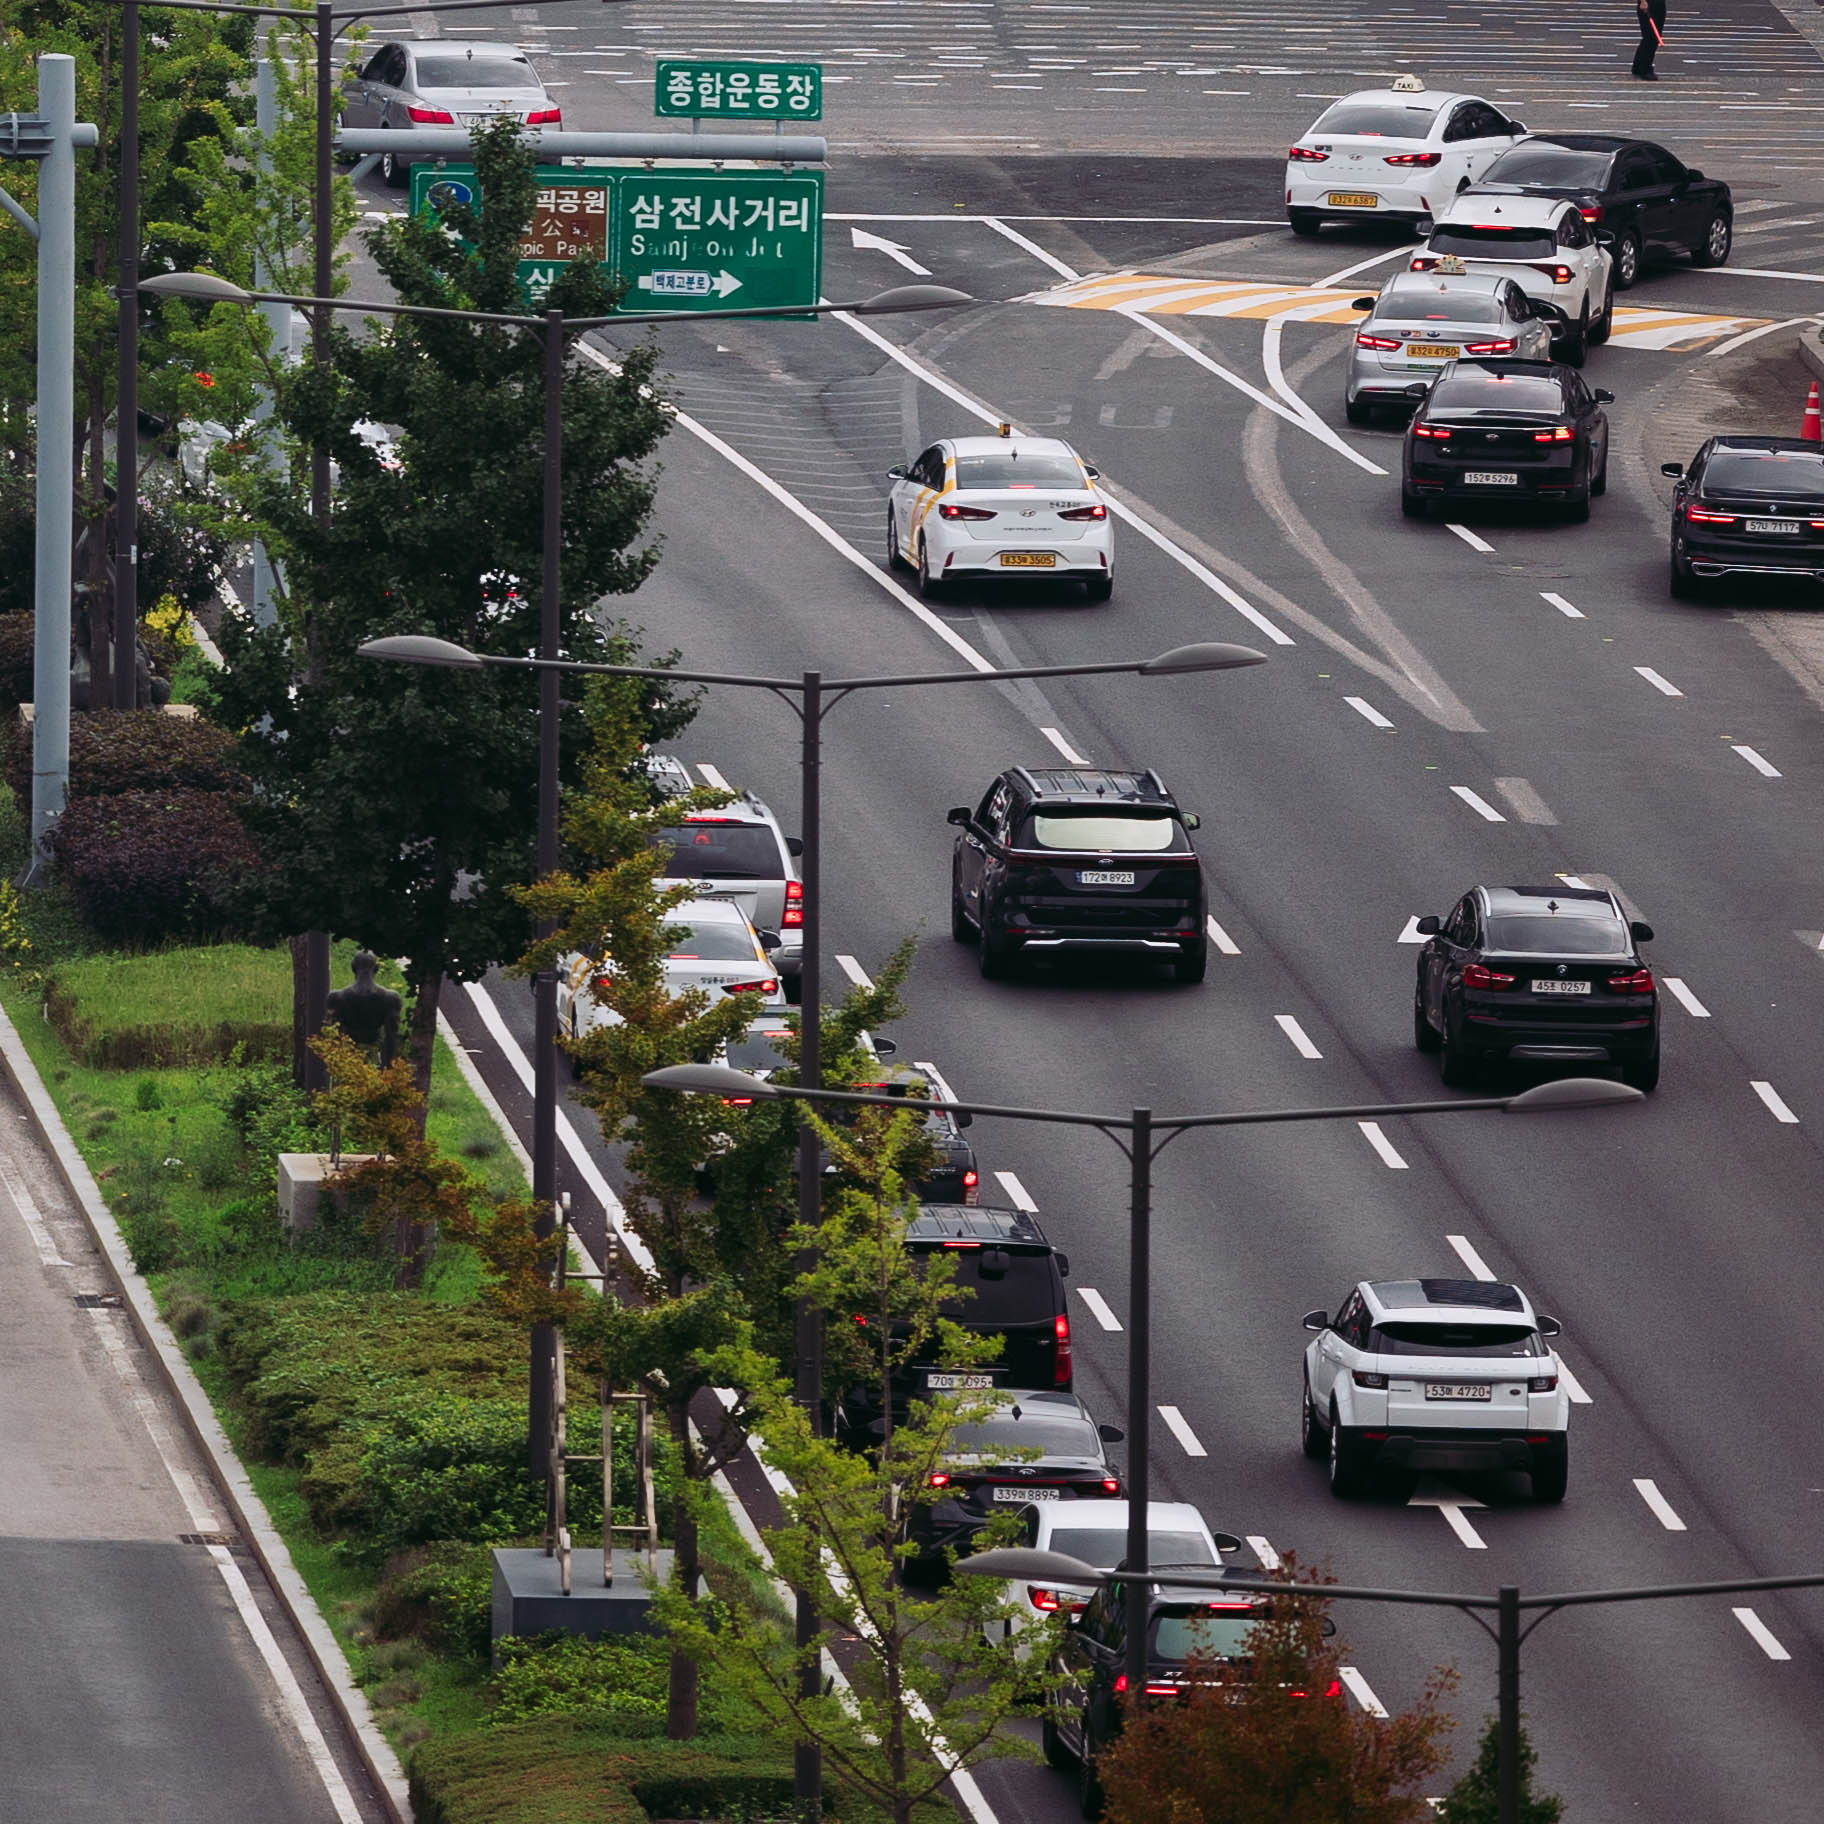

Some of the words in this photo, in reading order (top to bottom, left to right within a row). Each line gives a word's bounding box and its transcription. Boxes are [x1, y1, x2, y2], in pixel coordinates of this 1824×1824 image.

[666, 71, 815, 111] 종합운동장
[1397, 82, 1414, 90] TAXI
[628, 194, 810, 234] 삼전사거리
[1110, 873, 1133, 883] 8923
[1560, 981, 1586, 992] 0257
[1457, 1386, 1485, 1397] 4720
